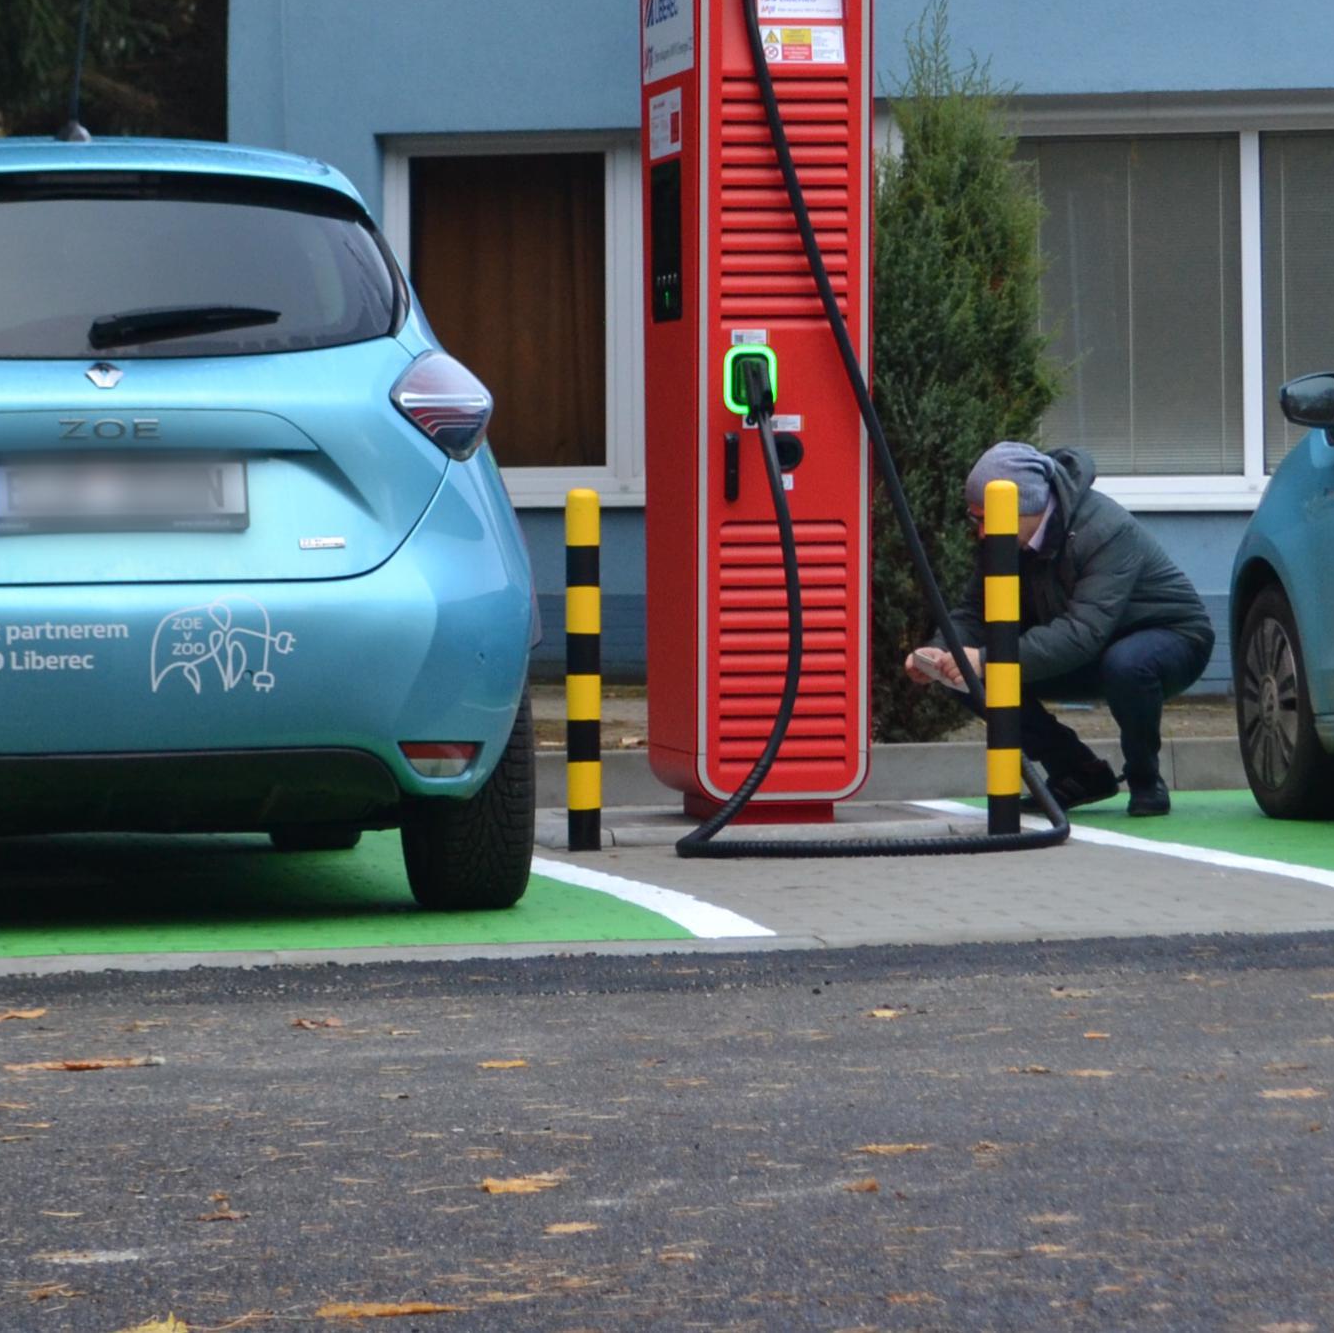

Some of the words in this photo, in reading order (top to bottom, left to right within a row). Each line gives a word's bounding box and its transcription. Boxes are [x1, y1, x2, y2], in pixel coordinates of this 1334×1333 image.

[58, 418, 161, 440] ZOE
[6, 621, 130, 646] partnerem
[170, 617, 204, 630] ZOE
[171, 642, 206, 656] ZOO
[10, 650, 95, 671] Liberec
